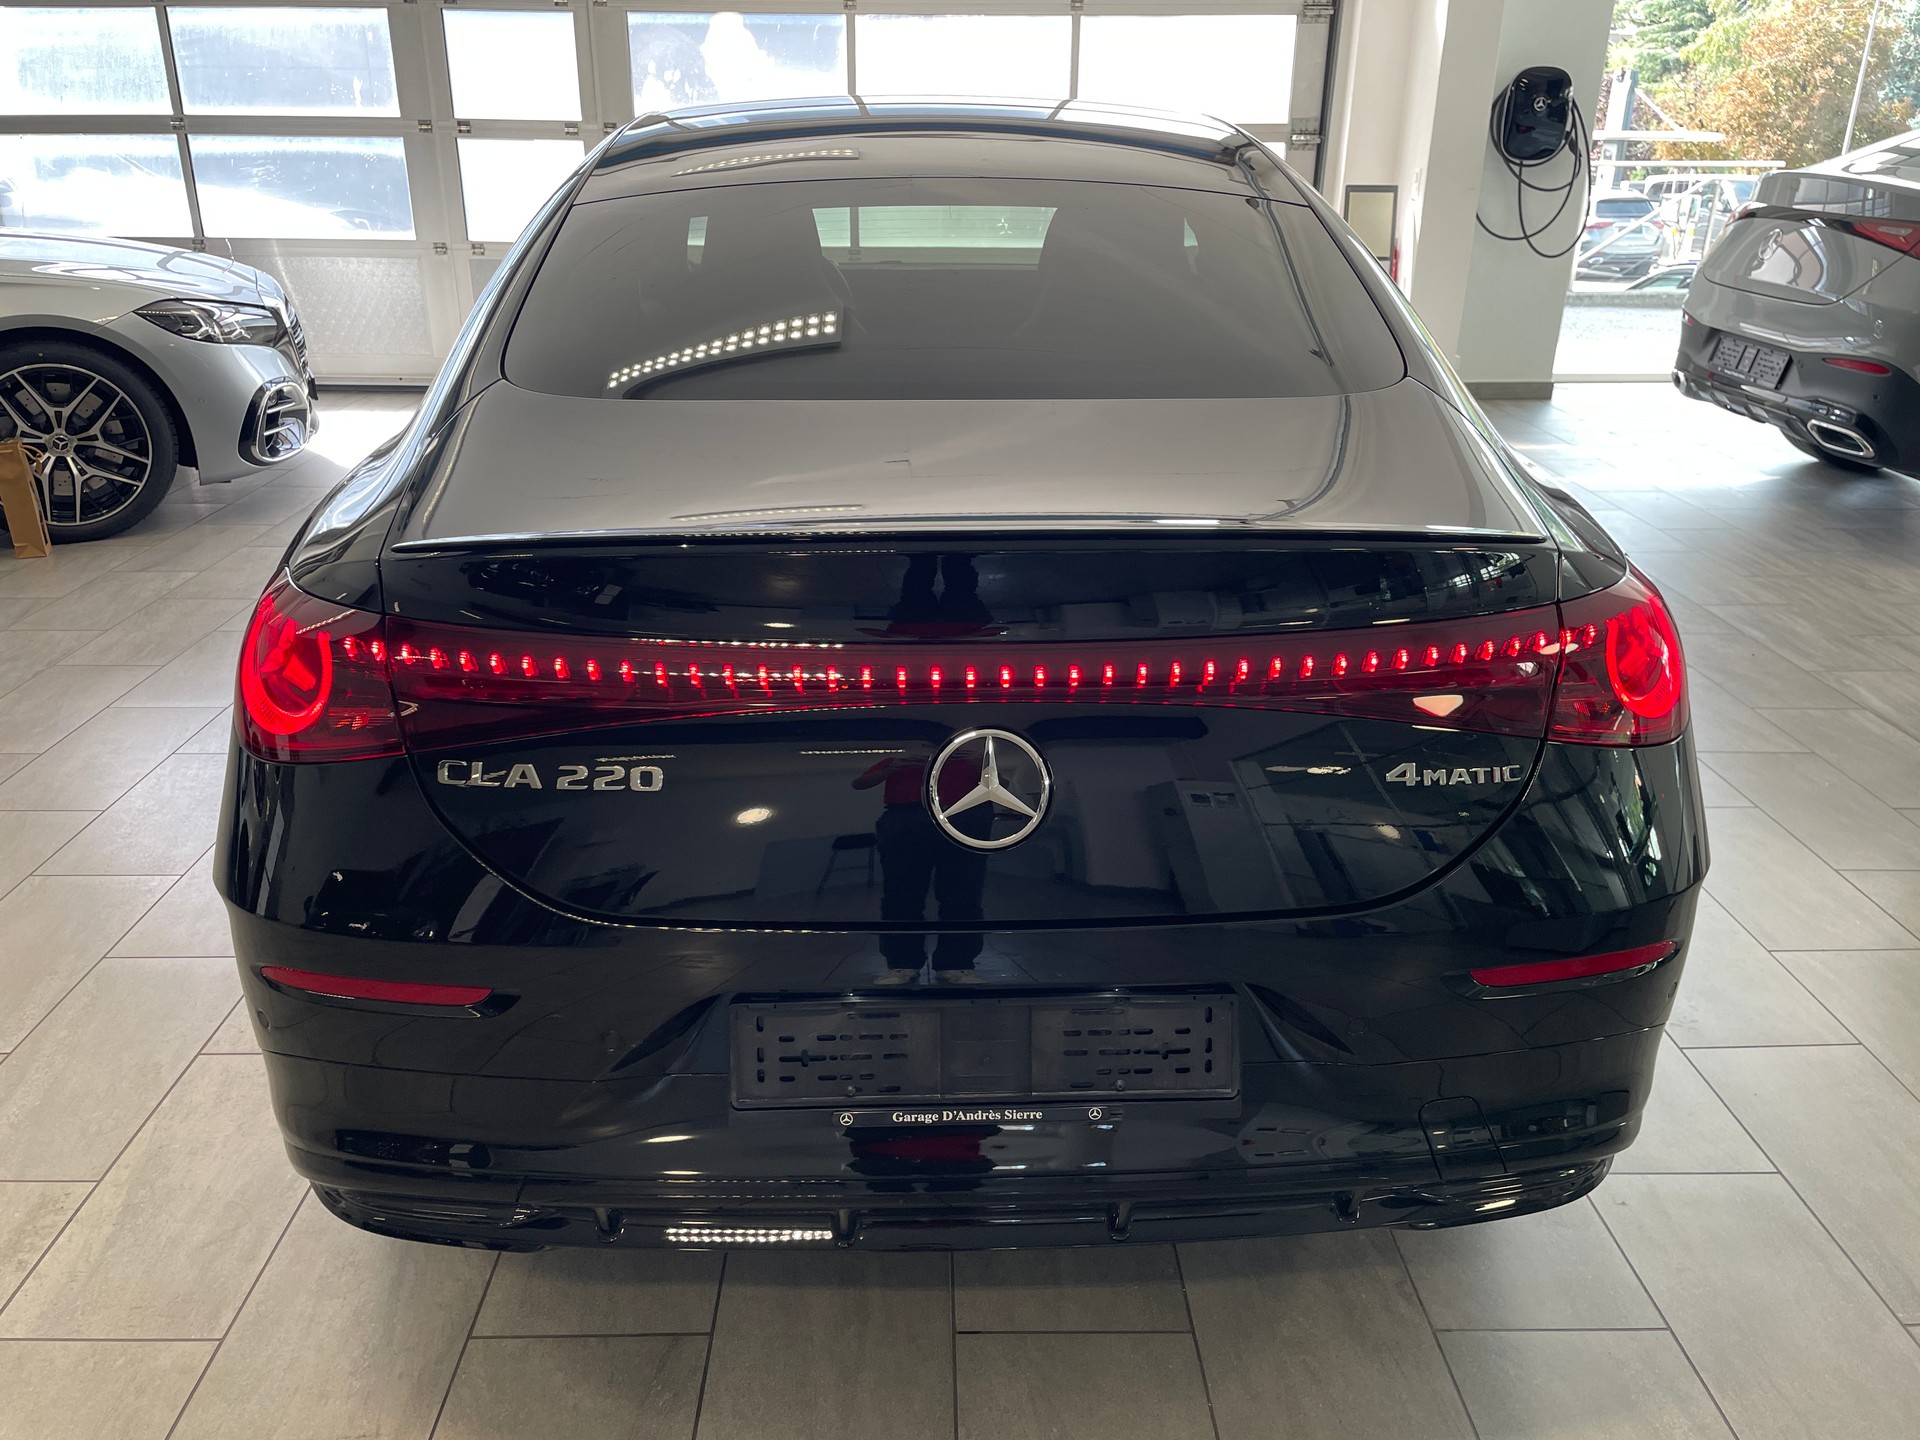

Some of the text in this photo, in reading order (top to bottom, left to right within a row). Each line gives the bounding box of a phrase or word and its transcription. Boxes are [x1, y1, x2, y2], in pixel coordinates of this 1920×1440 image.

[437, 759, 664, 792] CLA 220
[1385, 762, 1522, 787] 4MATIC
[892, 1109, 1043, 1125] Garage D'Andrès Sierre
